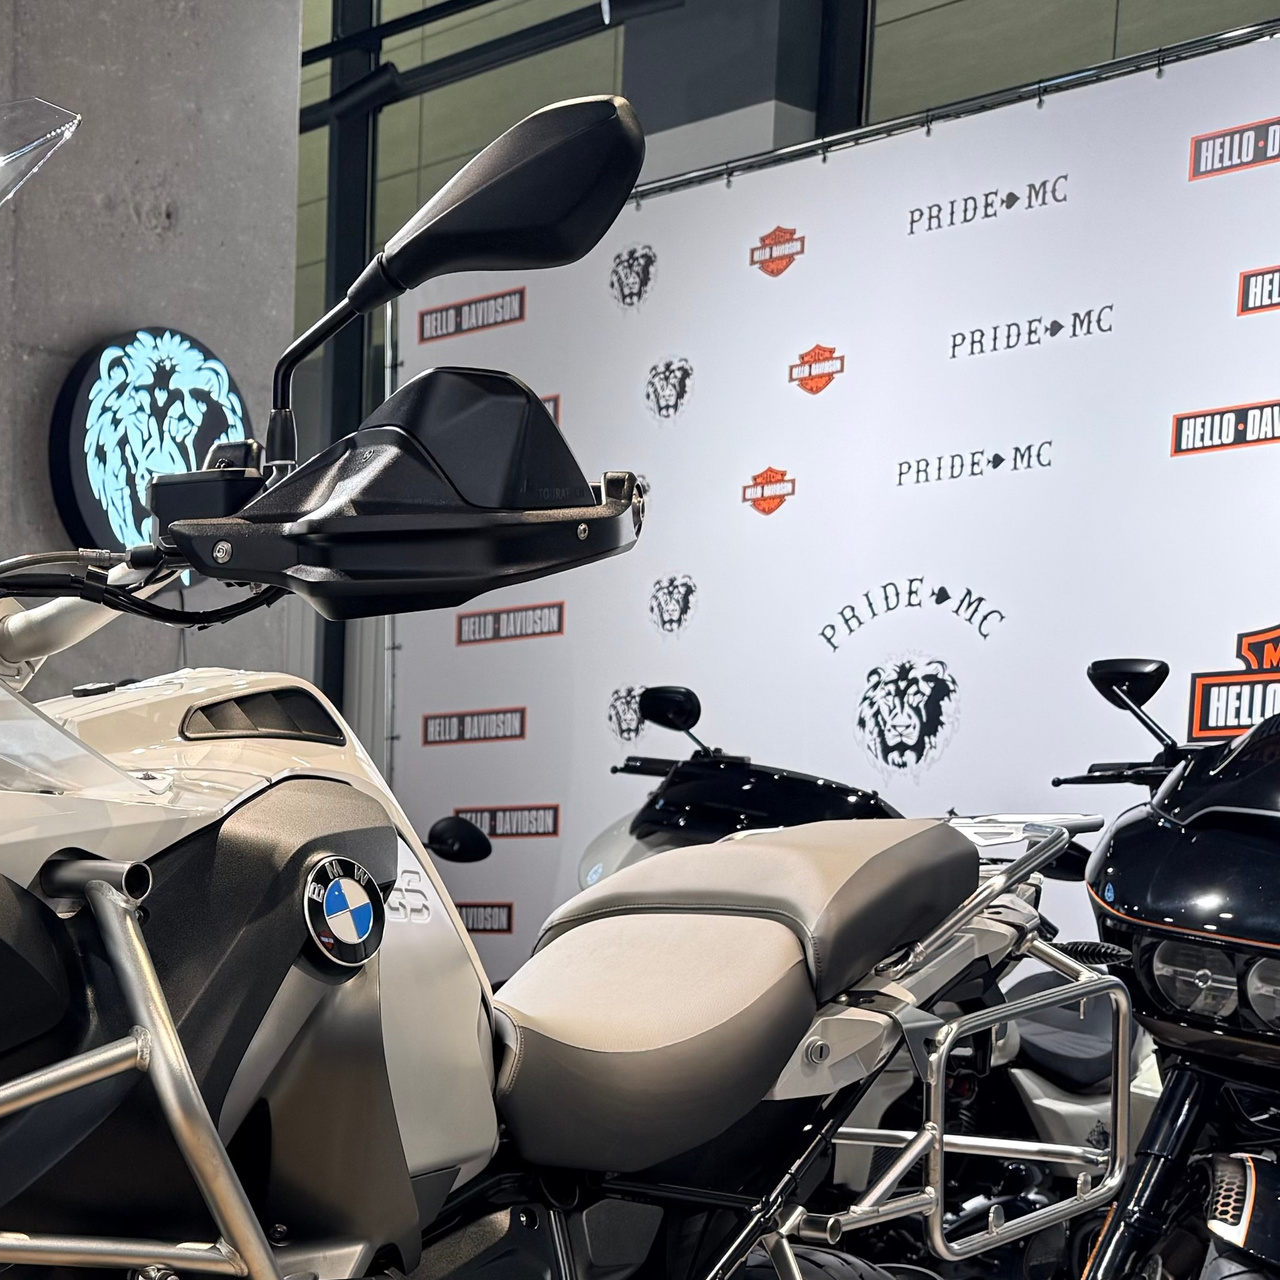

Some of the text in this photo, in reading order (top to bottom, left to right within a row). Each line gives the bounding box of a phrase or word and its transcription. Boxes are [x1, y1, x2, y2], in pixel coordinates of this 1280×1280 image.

[1200, 130, 1256, 172] HELLO
[907, 173, 1069, 236] PRIDE MC
[423, 293, 521, 339] HELLO DAVIDSON
[949, 304, 1114, 359] PRIDE MC
[1181, 412, 1236, 450] HELLO
[896, 440, 1053, 486] PRIDE MC
[461, 606, 560, 642] HELLO DAVIDSON
[818, 576, 1006, 653] PRIDE MC
[427, 712, 521, 742] HELLO DAVIDSON
[1208, 683, 1280, 727] HELLO
[495, 809, 555, 834] DAVIDSON
[308, 859, 369, 903] BMW
[459, 906, 509, 930] AVIDSON
